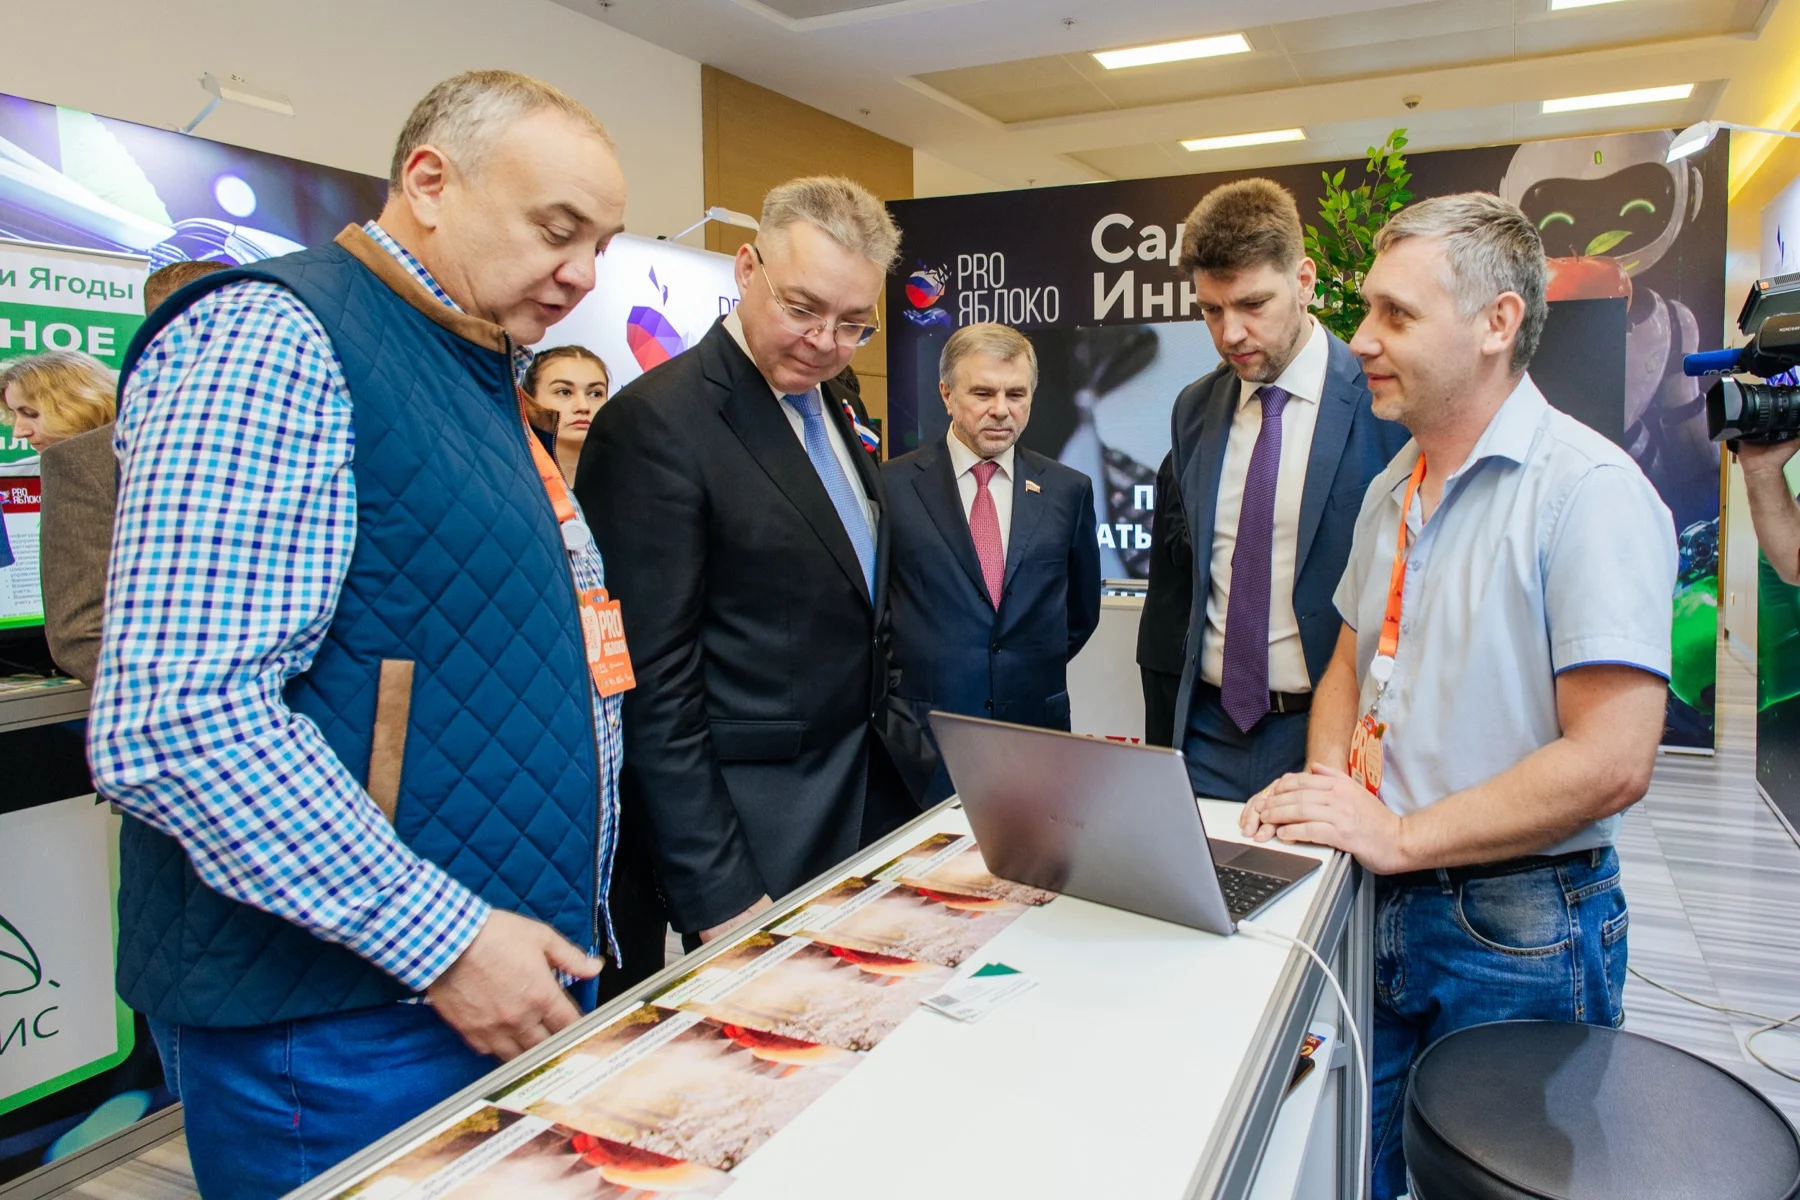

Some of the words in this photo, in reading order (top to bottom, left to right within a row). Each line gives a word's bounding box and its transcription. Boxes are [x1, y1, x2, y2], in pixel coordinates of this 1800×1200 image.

[0, 269, 16, 287] и
[29, 267, 133, 301] Ягоды
[957, 252, 1005, 290] PRO
[958, 285, 1060, 327] ЯБЛОКО
[0, 318, 116, 356] НОЕ
[13, 495, 41, 504] ЯБЛОК
[1097, 523, 1152, 549] АТЬ
[598, 608, 623, 640] PRO
